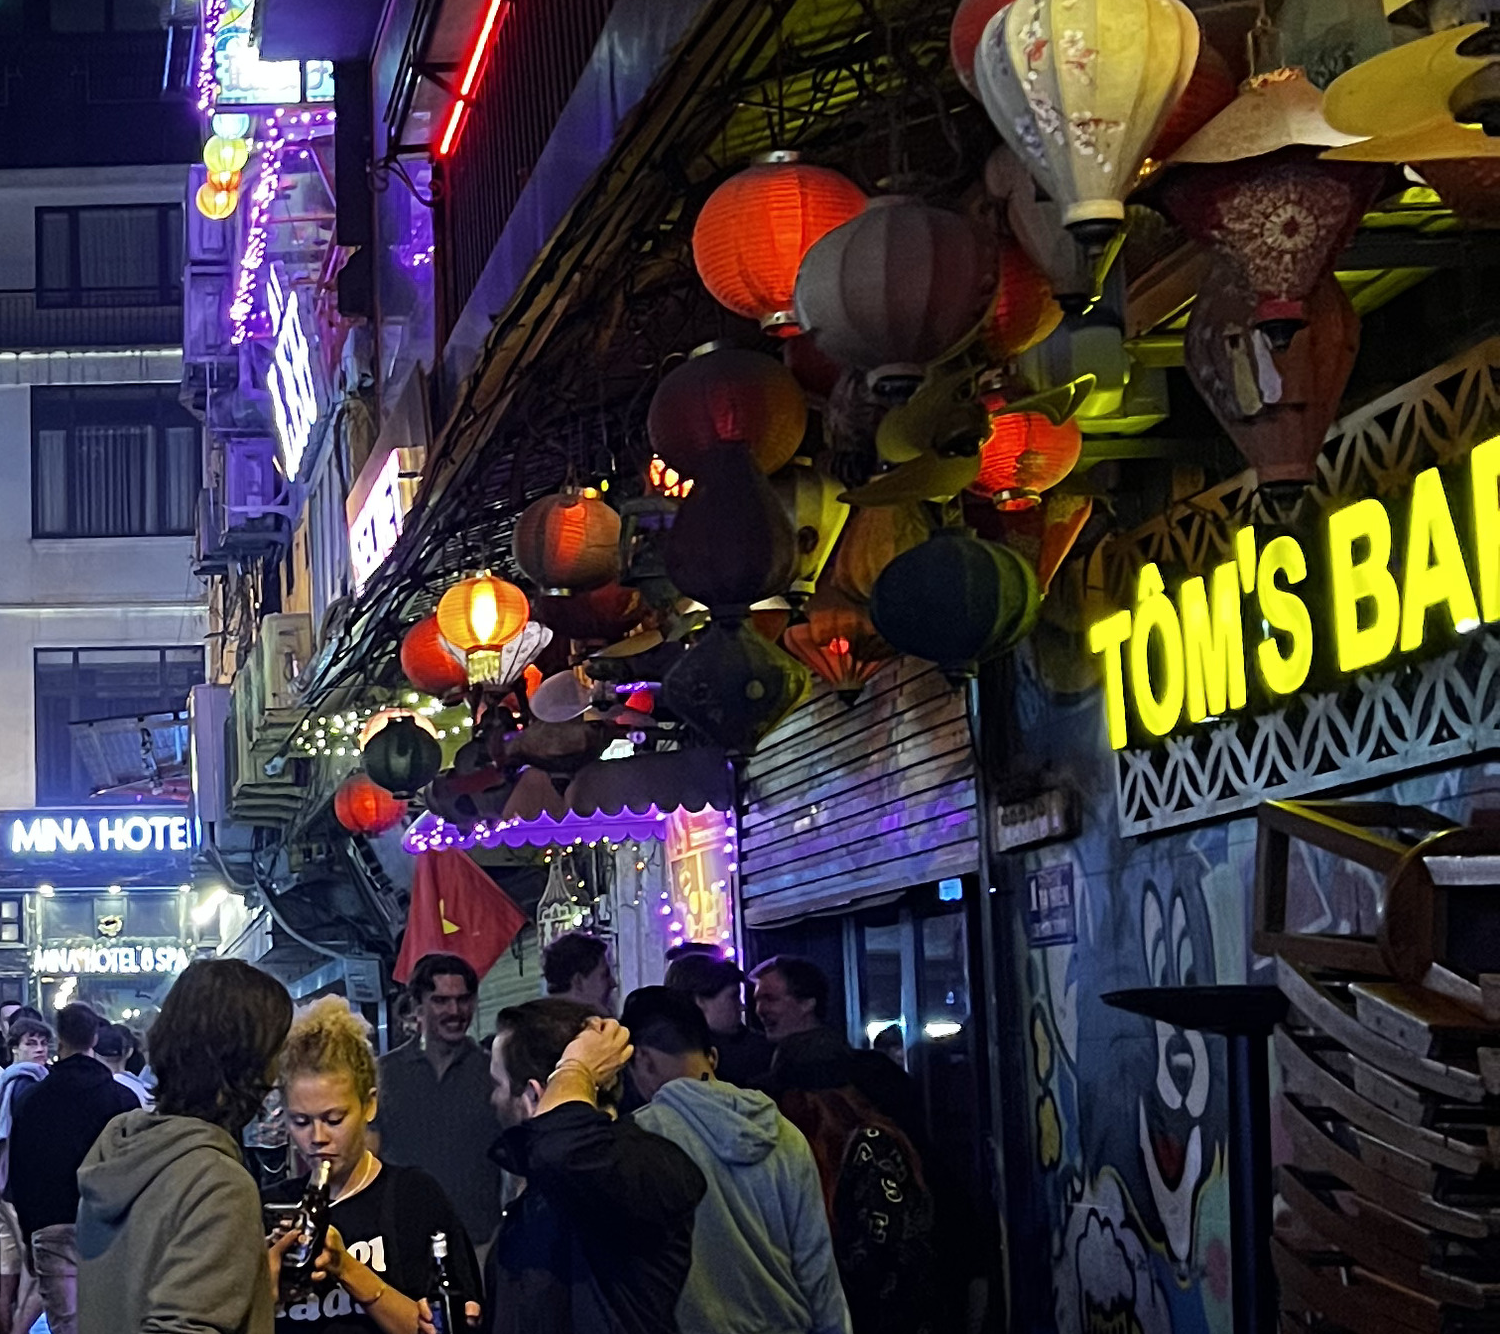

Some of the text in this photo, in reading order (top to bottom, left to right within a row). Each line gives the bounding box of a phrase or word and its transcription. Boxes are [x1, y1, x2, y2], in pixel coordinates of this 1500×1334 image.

[11, 817, 95, 853] MINA
[33, 946, 83, 974] MINA
[84, 947, 141, 974] HOTEL
[155, 946, 190, 974] SPA
